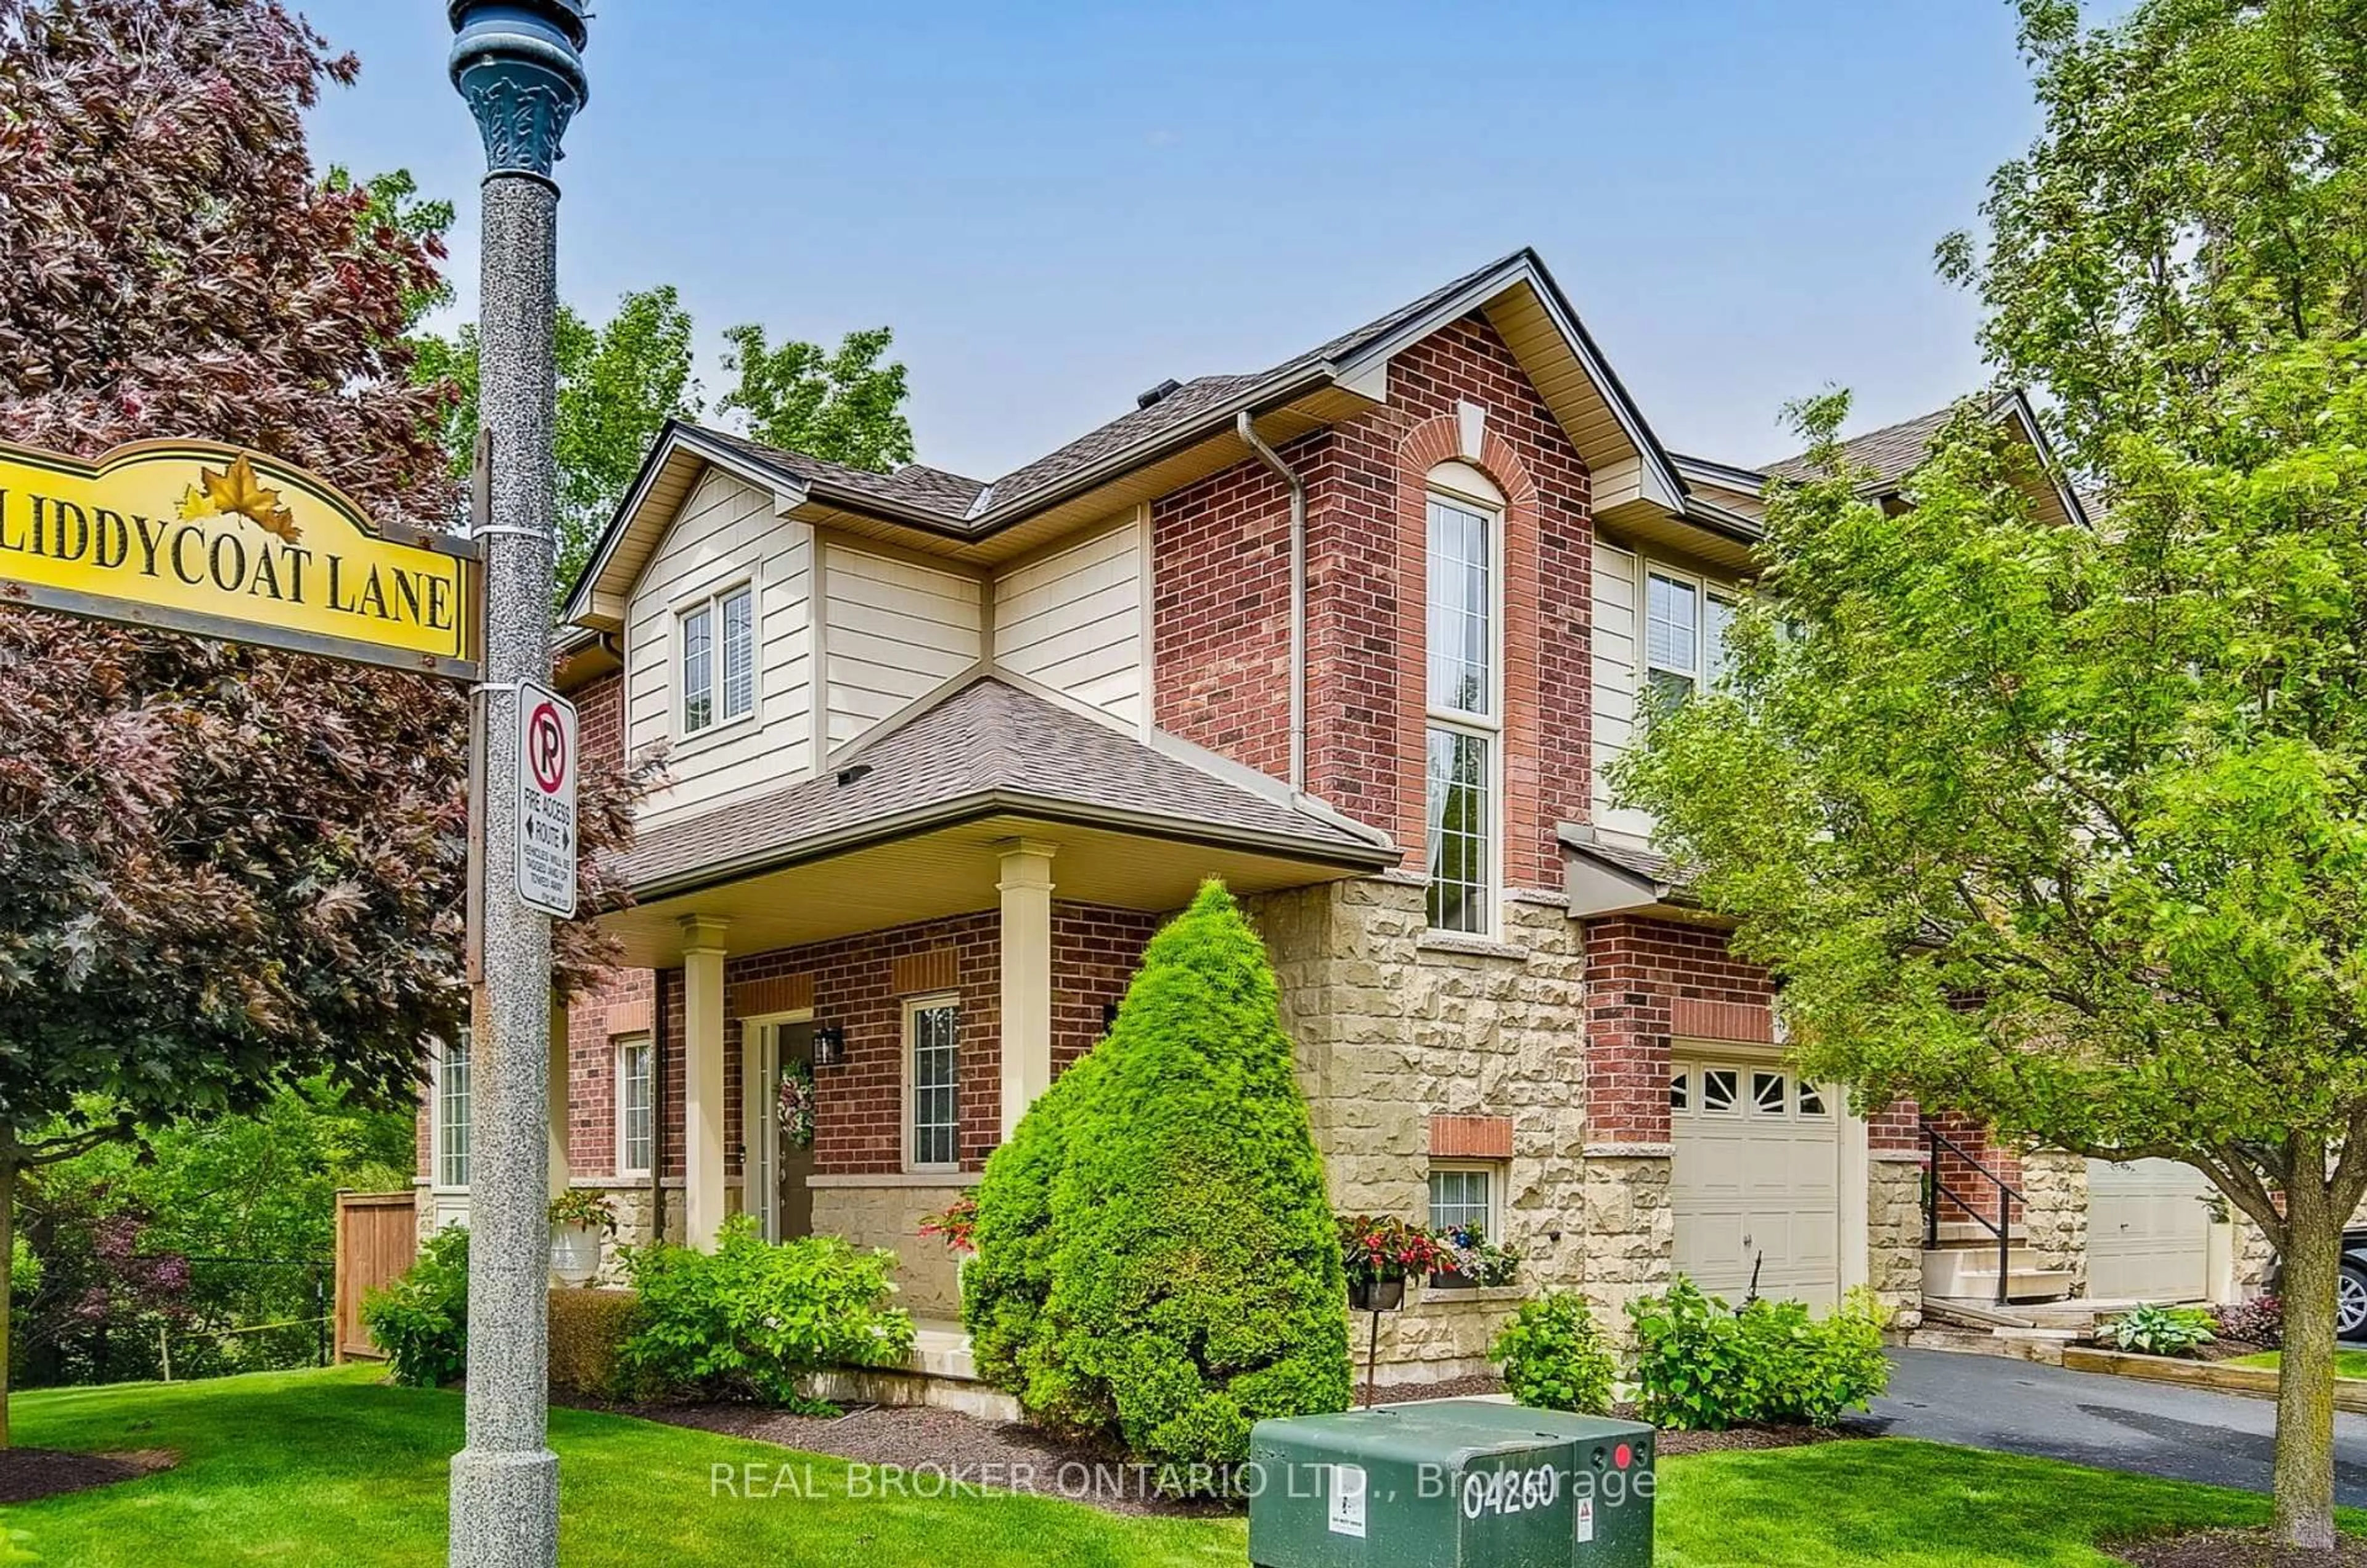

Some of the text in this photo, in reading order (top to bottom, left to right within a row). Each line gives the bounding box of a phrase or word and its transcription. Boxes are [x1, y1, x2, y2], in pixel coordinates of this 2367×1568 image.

[0, 489, 452, 631] LIDDYCOAT LANE
[1463, 1463, 1555, 1519] 04260
